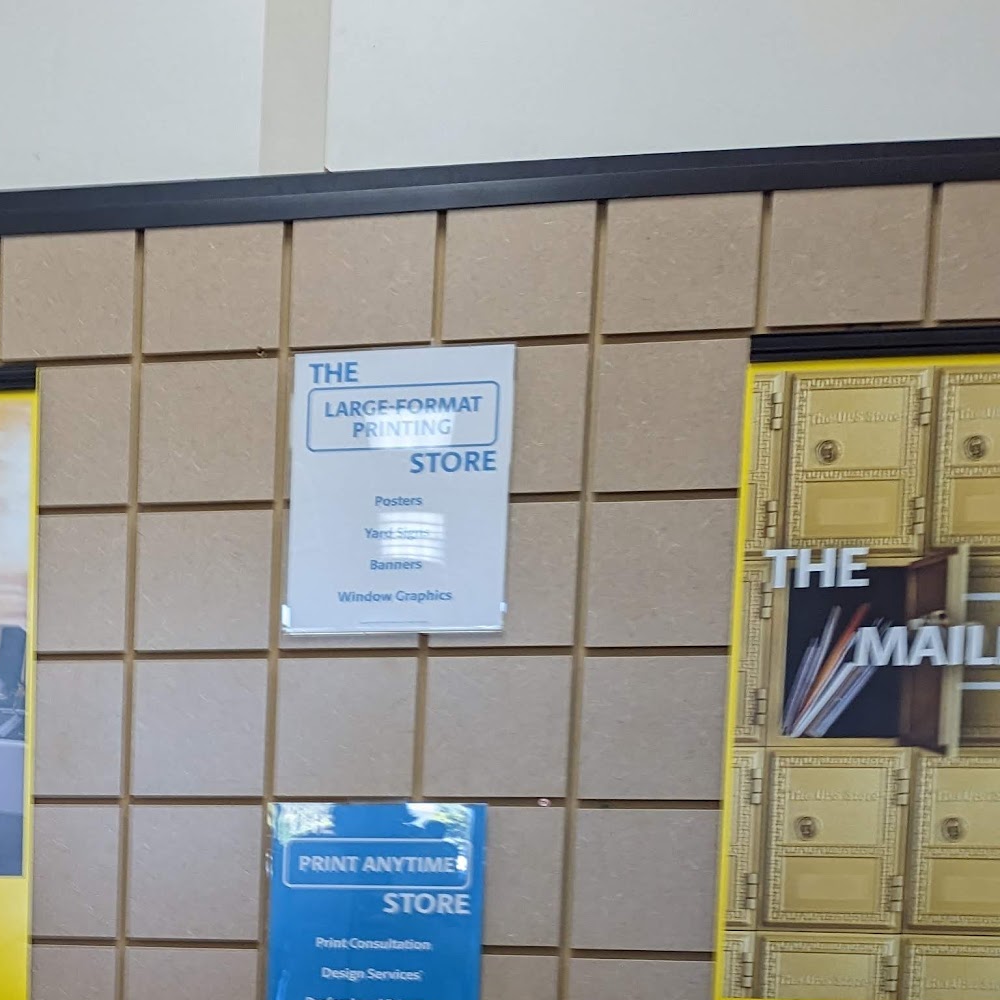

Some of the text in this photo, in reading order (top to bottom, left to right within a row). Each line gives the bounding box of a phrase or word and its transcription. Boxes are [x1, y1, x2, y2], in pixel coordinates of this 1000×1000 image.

[308, 362, 359, 384] THE
[323, 396, 484, 418] LARGE-FORMAT
[352, 419, 453, 438] PRINTING
[410, 450, 498, 474] STORE
[374, 495, 423, 507] Posters
[364, 528, 393, 539] Yard
[370, 559, 423, 570] Banners
[764, 547, 870, 588] THE
[337, 589, 453, 604] Window Graphics
[852, 624, 1000, 666] MAIL
[298, 855, 457, 873] PRINT ANYTIME
[382, 892, 472, 915] STORE
[315, 936, 432, 951] Print Consultation
[321, 967, 422, 983] Design Services
